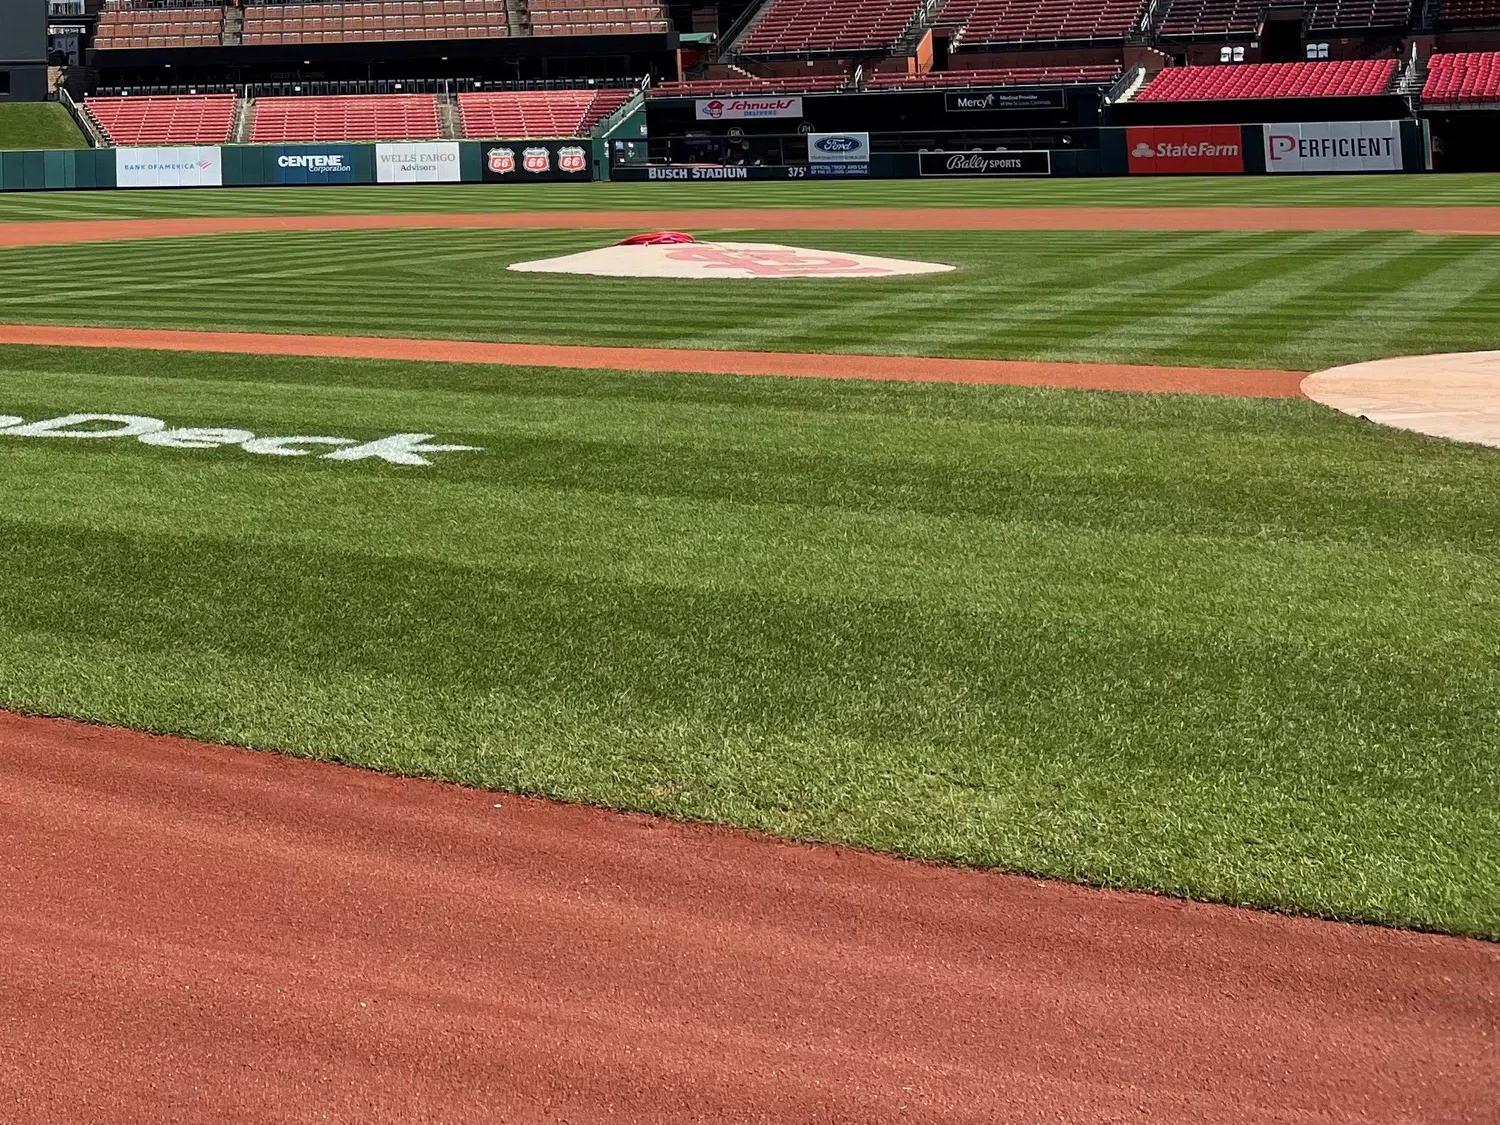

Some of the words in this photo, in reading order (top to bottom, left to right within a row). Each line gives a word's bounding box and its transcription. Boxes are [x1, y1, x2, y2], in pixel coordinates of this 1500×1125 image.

[728, 100, 794, 111] Schnucks
[957, 98, 987, 108] Mercy
[823, 139, 852, 150] Ford
[1269, 135, 1393, 160] PERFICIENT
[278, 155, 342, 167] CENTENE
[381, 154, 417, 163] WELLS
[420, 153, 456, 162] FARGO
[493, 158, 509, 168] 66
[528, 157, 544, 167] 66
[563, 156, 579, 166] 66
[946, 154, 988, 172] Bally
[990, 159, 1021, 168] SPORTS
[309, 164, 351, 173] Corporation
[400, 164, 436, 172] Advisors
[649, 167, 688, 178] BUSCH
[692, 166, 747, 178] STADIUM
